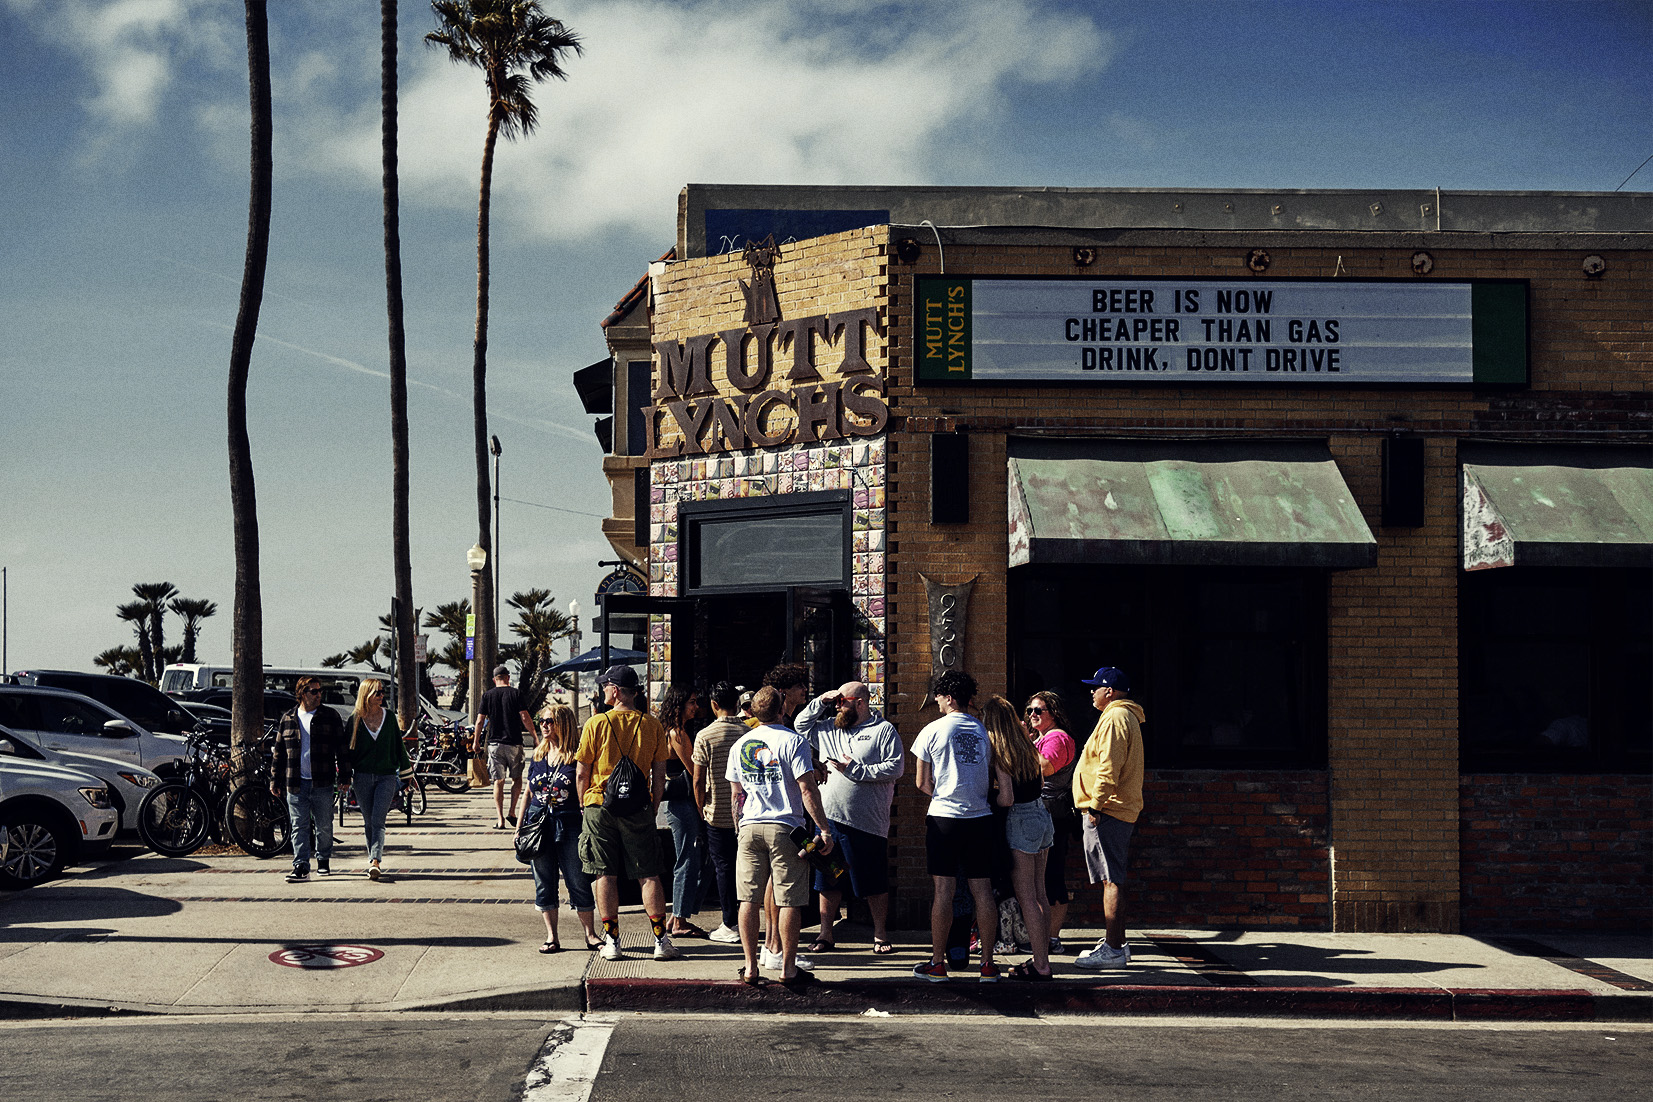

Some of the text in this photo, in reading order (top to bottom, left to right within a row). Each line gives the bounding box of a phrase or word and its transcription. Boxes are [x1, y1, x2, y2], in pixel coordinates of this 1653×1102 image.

[926, 298, 943, 359] MUTT
[948, 286, 965, 373] LYNCH'S
[1065, 318, 1340, 343] CHEAPER THAN GAS
[1092, 289, 1273, 314] BEER IS NOW
[652, 306, 879, 400] MUTT
[1081, 347, 1341, 372] DRINK, DONT DRIVE
[640, 373, 888, 460] LYNCHS
[939, 592, 957, 678] 230
